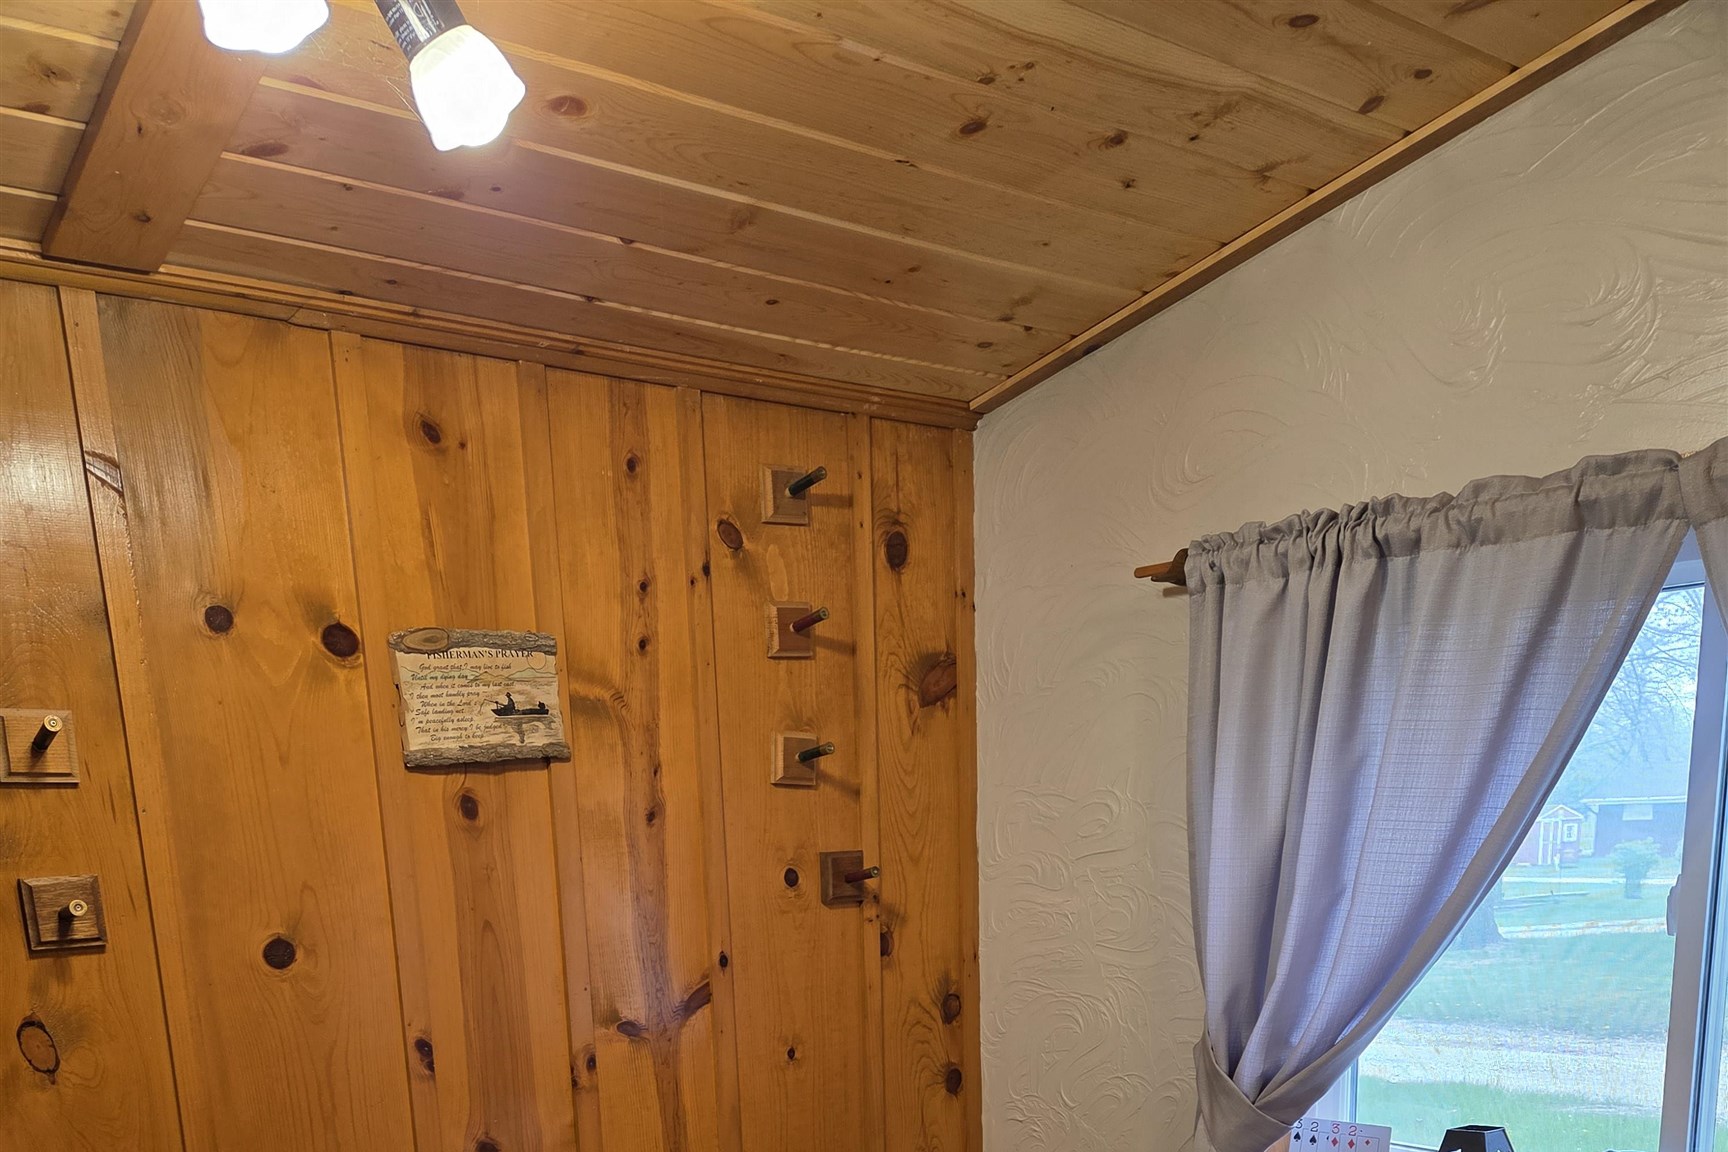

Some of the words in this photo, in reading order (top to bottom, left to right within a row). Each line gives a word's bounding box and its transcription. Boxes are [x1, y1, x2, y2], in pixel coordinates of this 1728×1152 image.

[427, 649, 494, 660] FISHERMAN'S
[495, 649, 534, 659] PRAYER
[419, 663, 431, 672] God
[450, 662, 462, 670] that
[501, 662, 512, 671] fish
[411, 673, 428, 681] Until
[440, 673, 456, 681] dying
[420, 682, 434, 690] And
[416, 692, 428, 700] then
[445, 690, 465, 698] humbly
[420, 700, 437, 708] When
[415, 708, 429, 717] Safe
[425, 716, 454, 725] peacefully
[415, 726, 431, 734] That
[430, 734, 442, 742] Big
[443, 732, 463, 741] enough
[1310, 1122, 1319, 1132] 2
[1332, 1123, 1340, 1134] 3
[1349, 1125, 1357, 1136] 2
